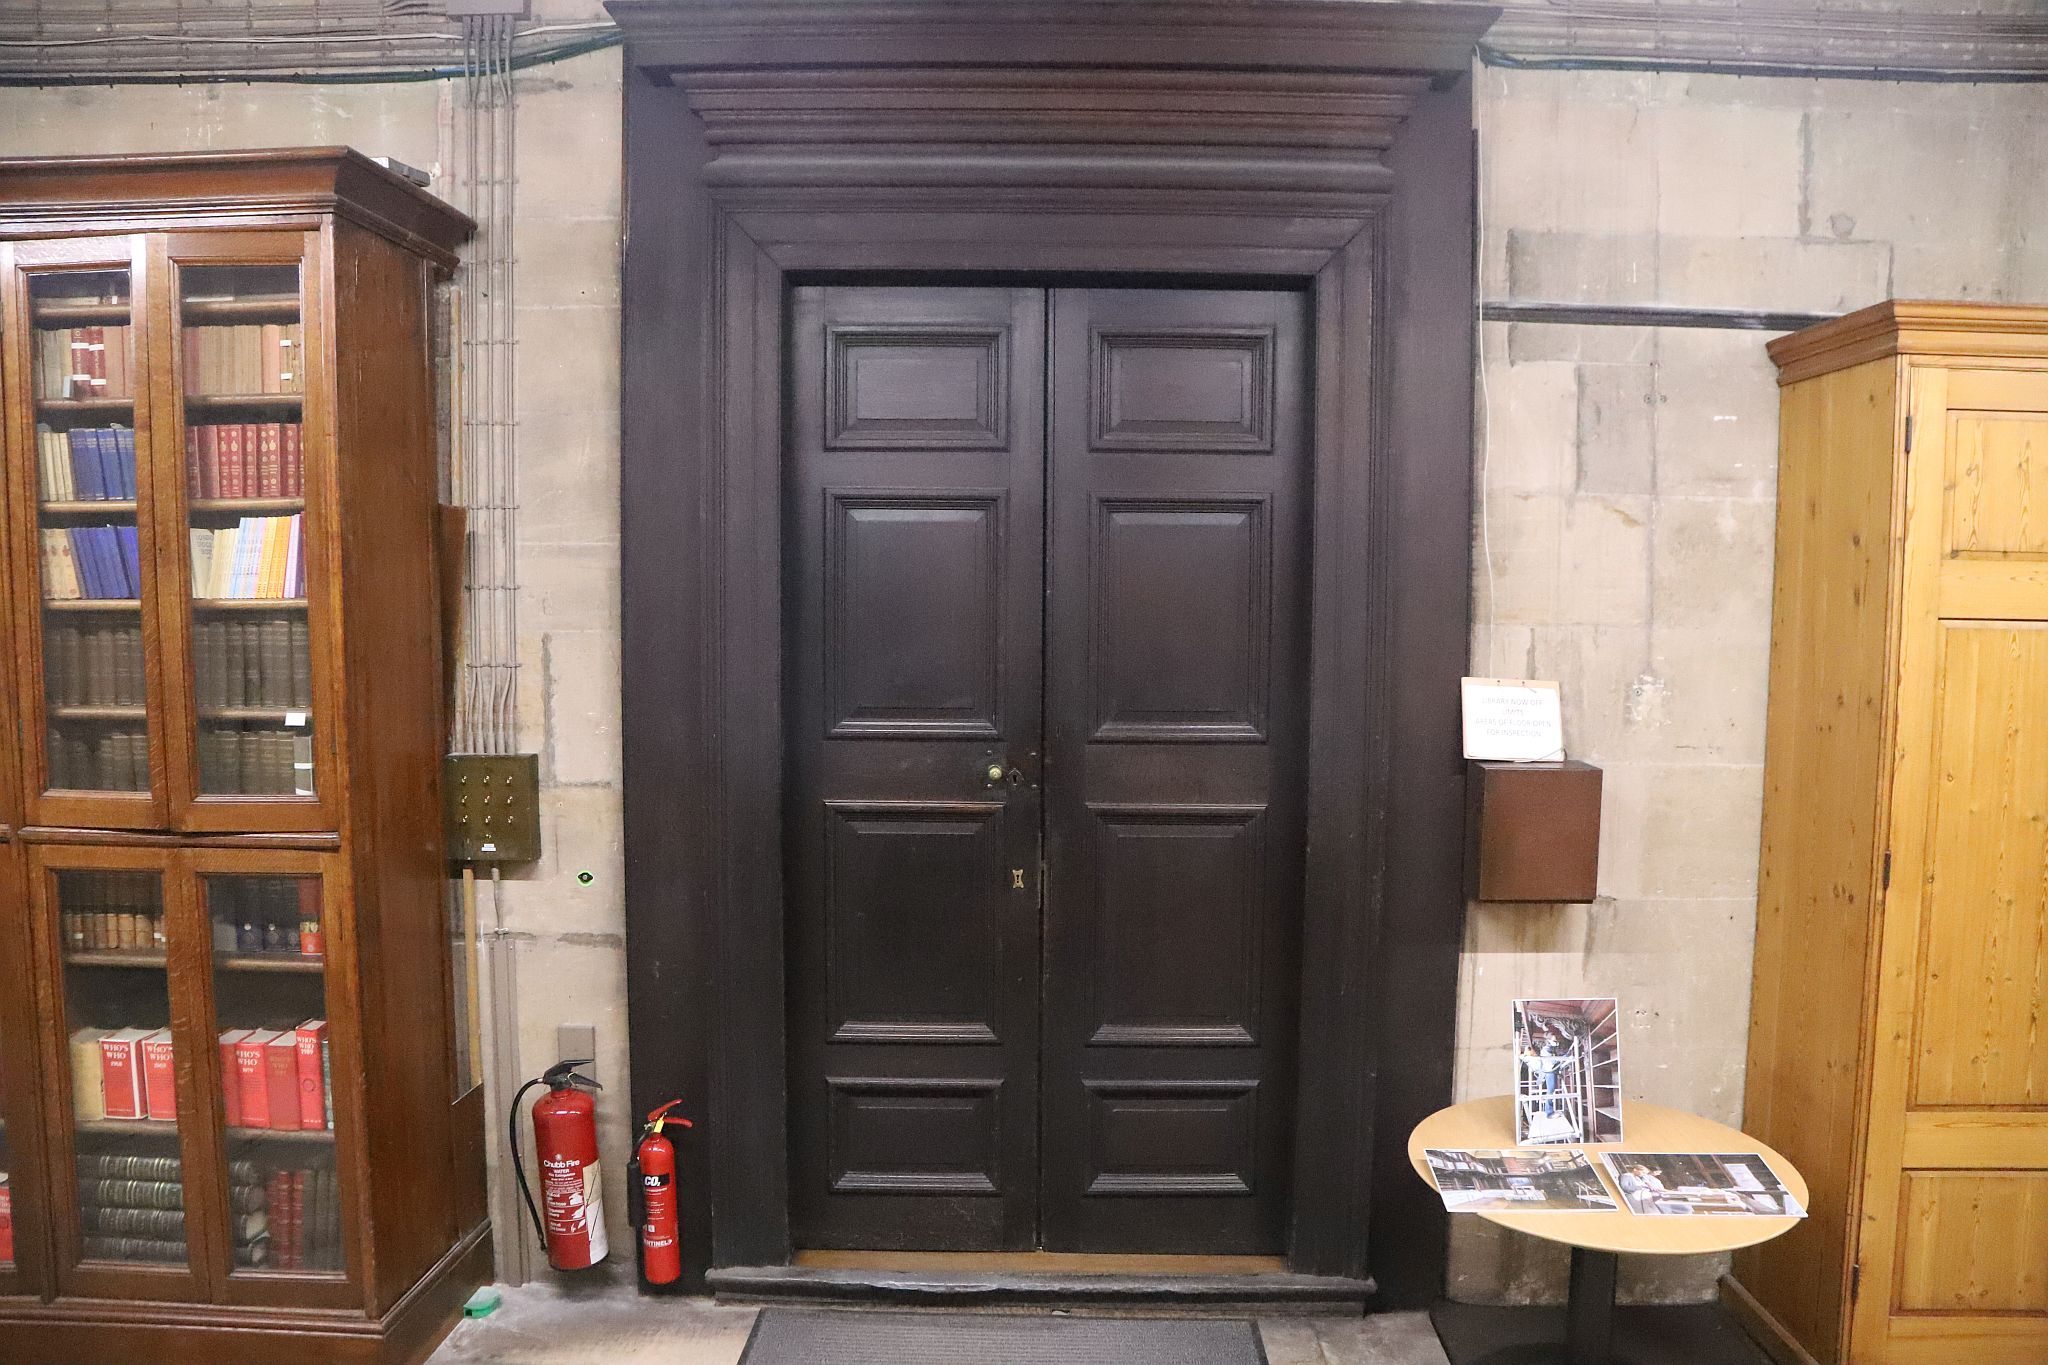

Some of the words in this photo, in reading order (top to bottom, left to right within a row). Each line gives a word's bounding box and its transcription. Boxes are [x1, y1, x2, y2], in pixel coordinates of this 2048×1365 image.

[1481, 697, 1509, 705] LIBRARY
[1511, 698, 1529, 706] NOW
[1530, 698, 1544, 706] OFF
[1532, 720, 1552, 728] OPEN
[1486, 729, 1501, 737] FOR
[1502, 729, 1541, 737] INSPECTION
[103, 1043, 129, 1052] WHO'S
[106, 1051, 126, 1060] WHO
[150, 1053, 170, 1061] WHO
[543, 1159, 566, 1168] Chubb
[566, 1159, 580, 1167] Fire
